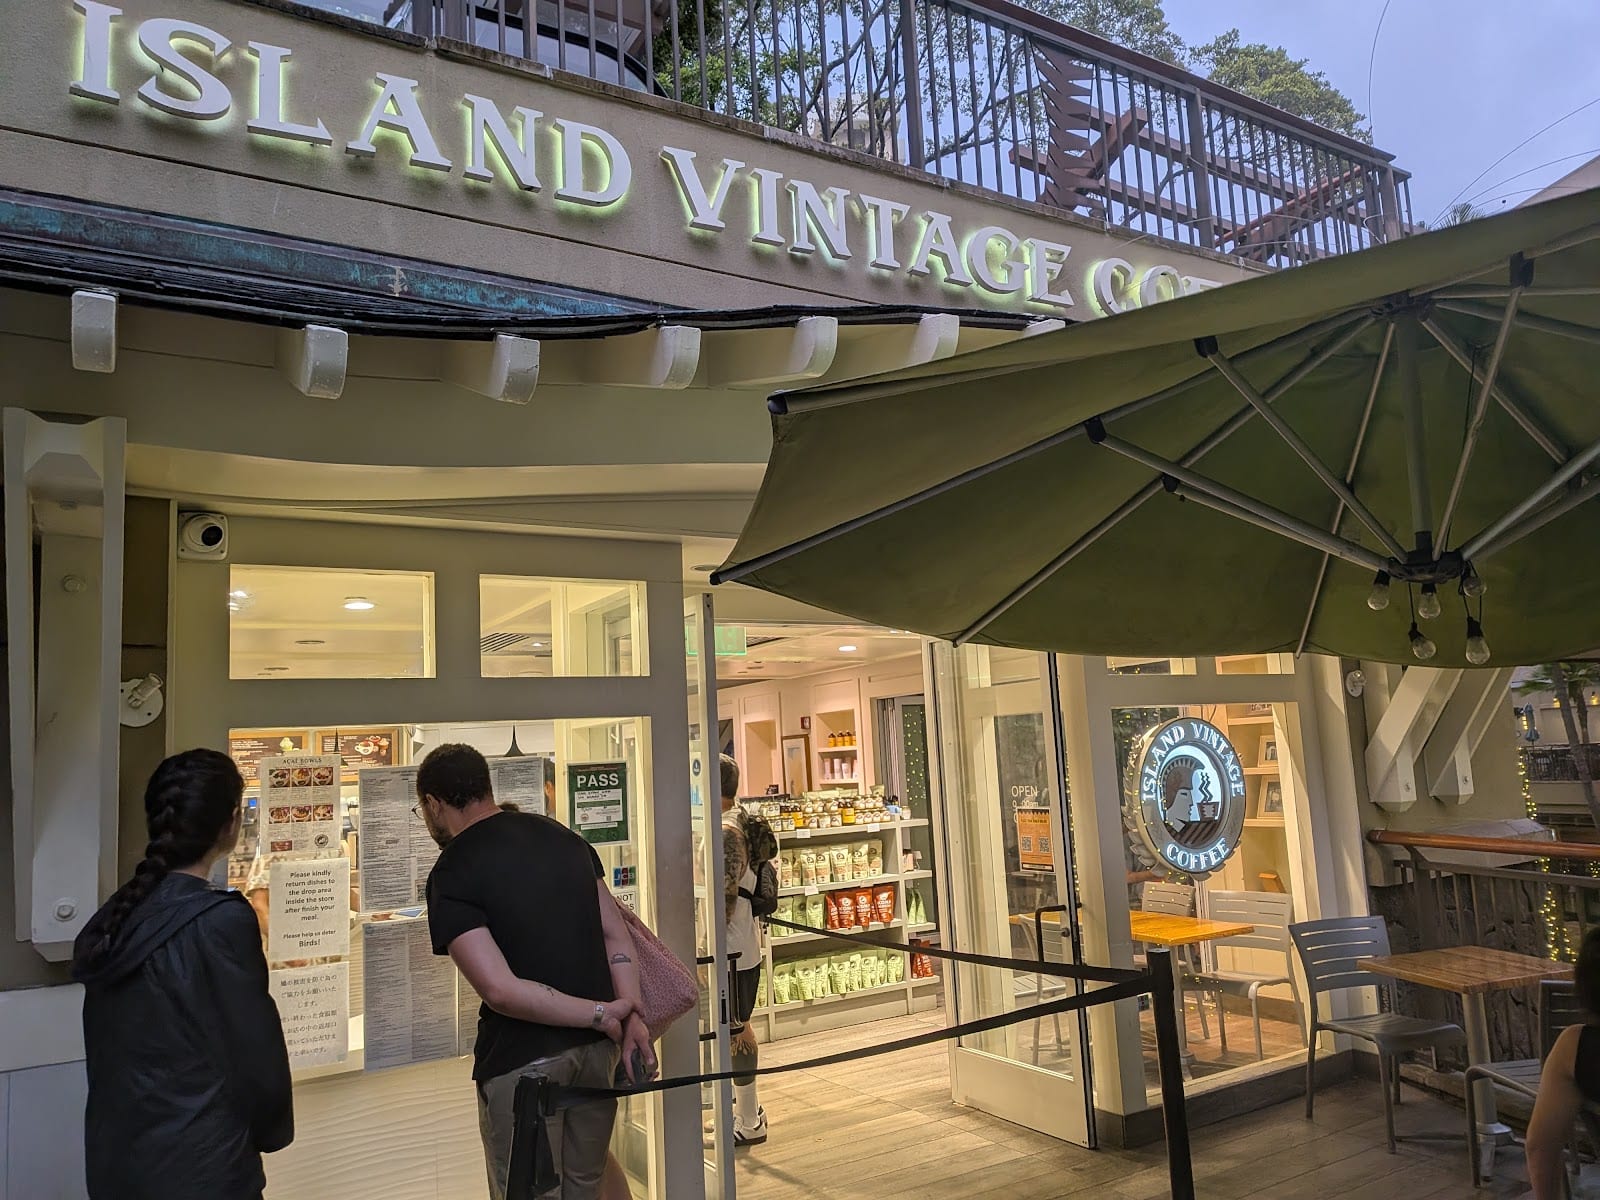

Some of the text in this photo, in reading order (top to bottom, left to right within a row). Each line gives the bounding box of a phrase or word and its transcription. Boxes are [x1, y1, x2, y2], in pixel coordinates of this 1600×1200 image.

[68, 0, 1224, 316] ISLAND VINTAGE CO
[1142, 721, 1245, 801] ISLAND VINTAGE
[577, 773, 619, 788] PASS
[1011, 785, 1038, 797] OPEN
[1166, 837, 1230, 870] COFFEE
[299, 939, 321, 947] Birds!
